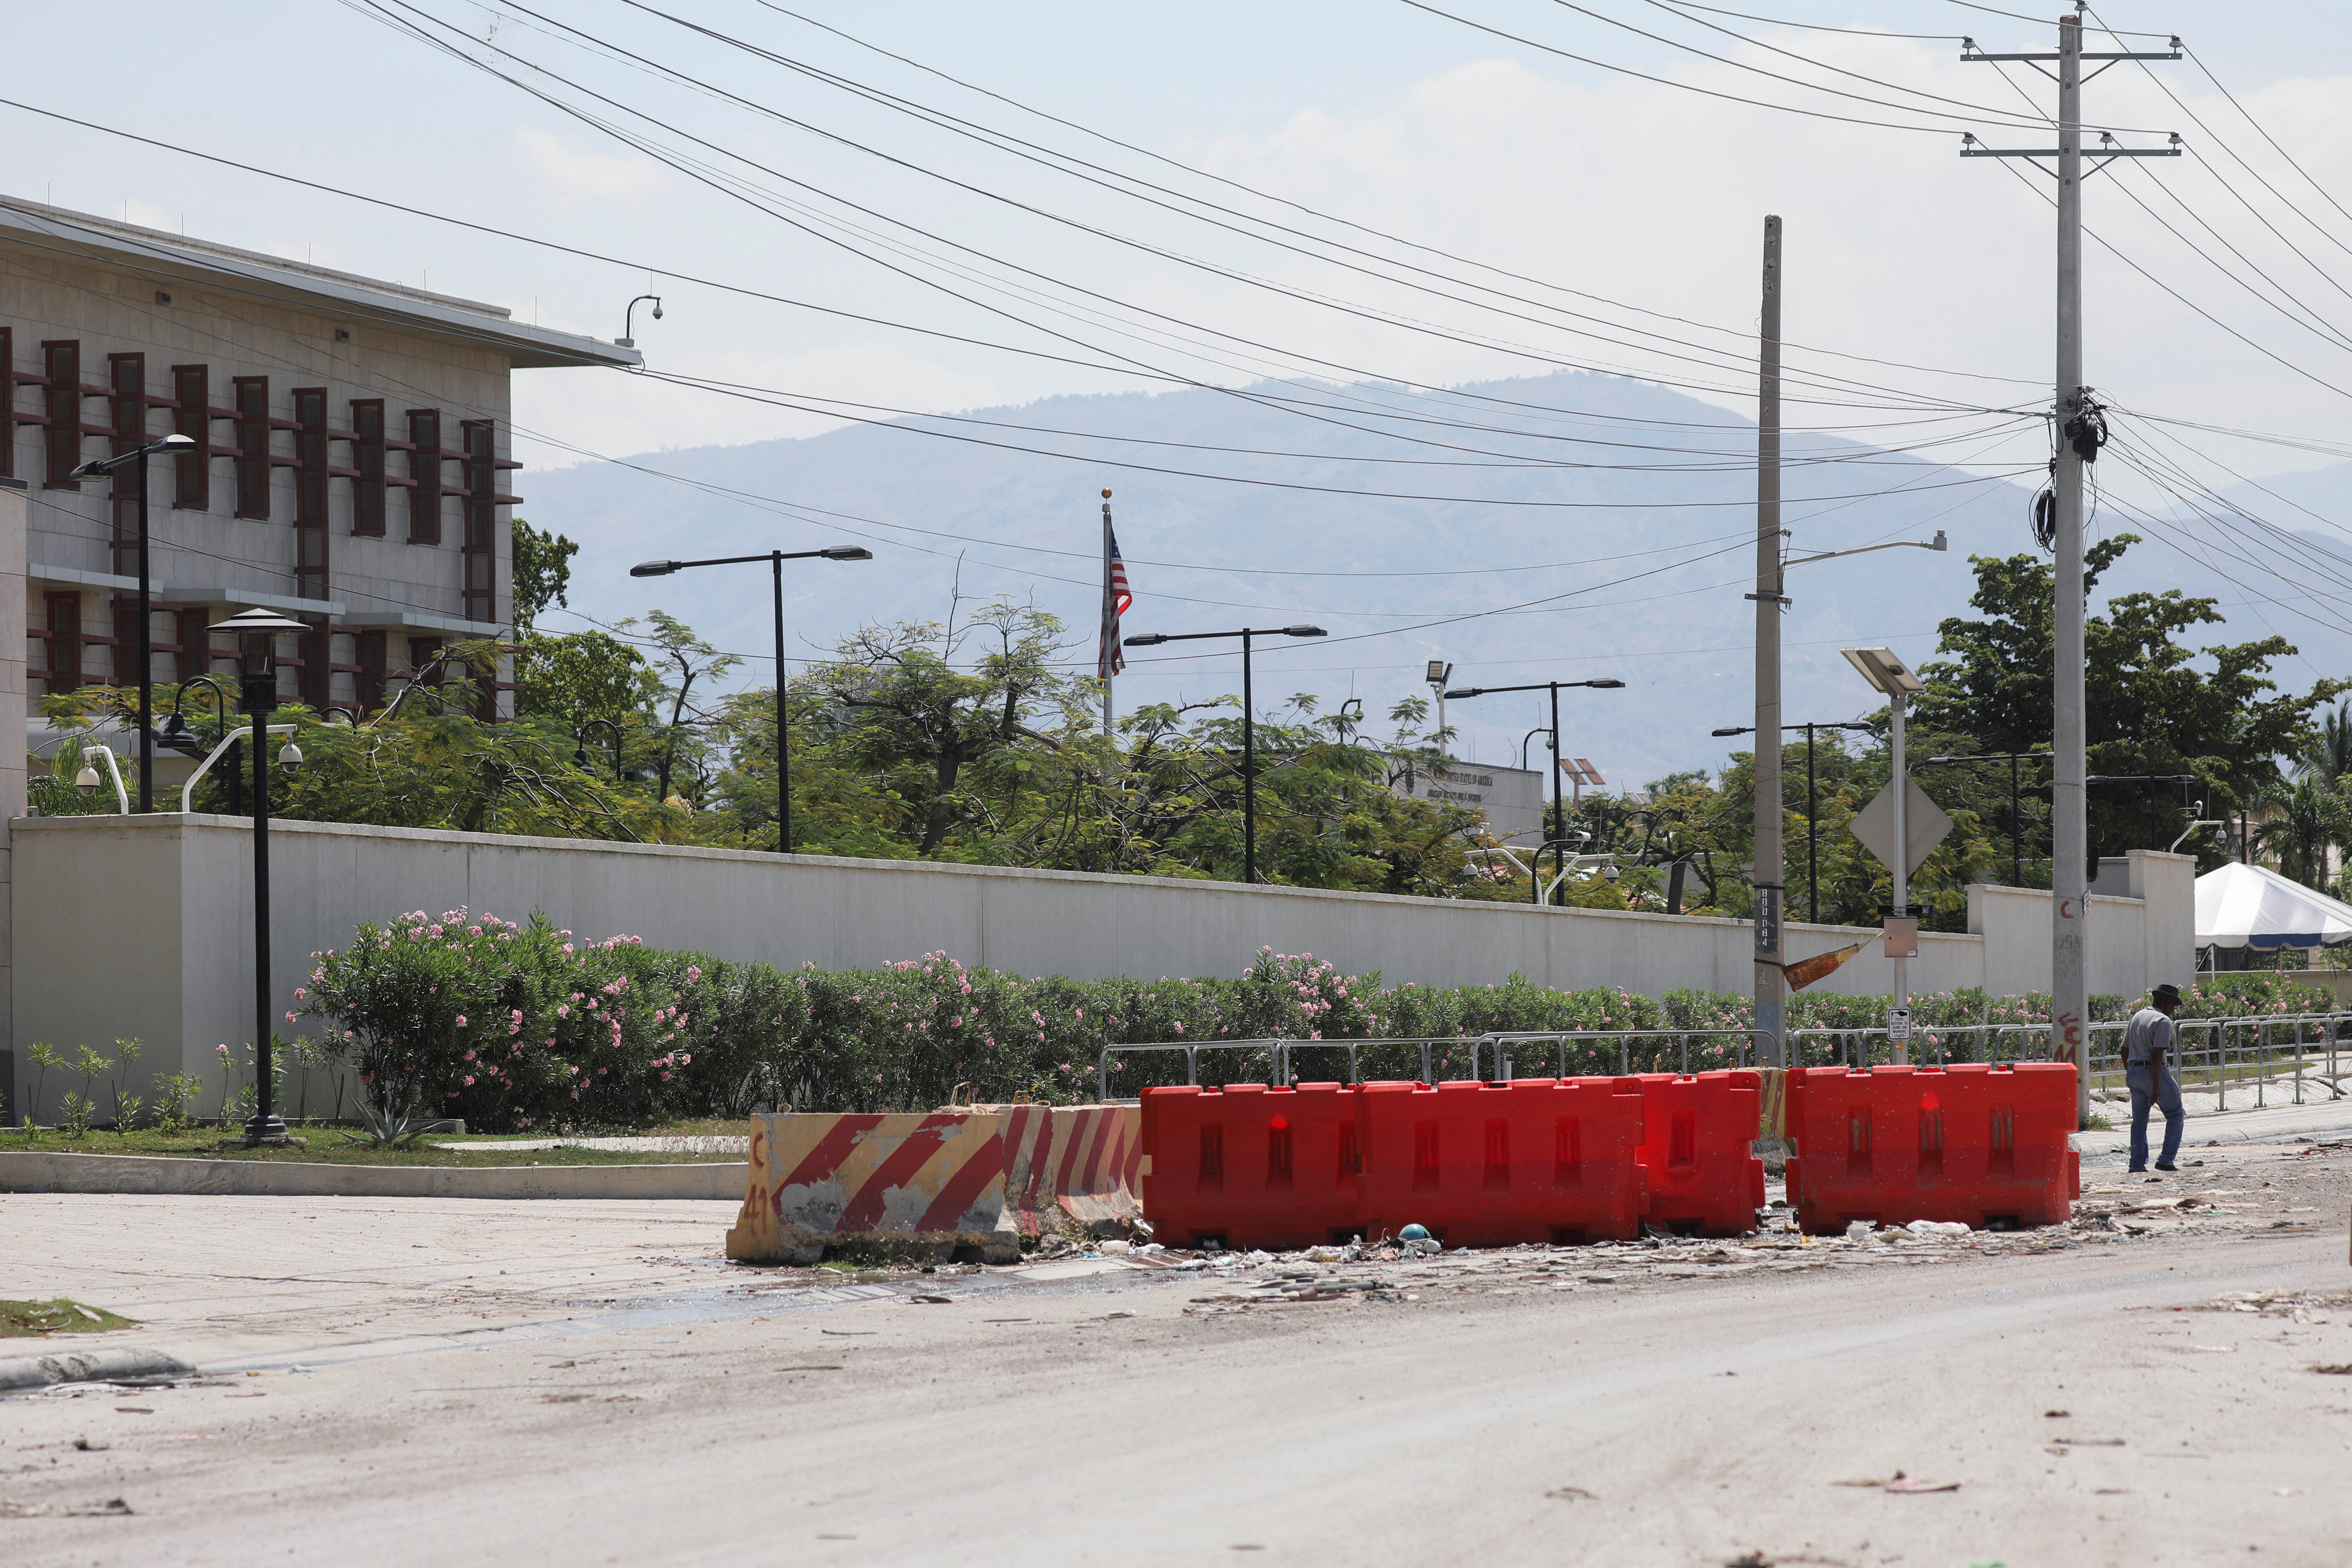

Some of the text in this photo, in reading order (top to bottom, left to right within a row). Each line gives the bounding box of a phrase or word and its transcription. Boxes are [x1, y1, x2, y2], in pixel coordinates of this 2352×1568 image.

[1460, 773, 1472, 784] STATES
[1478, 775, 1493, 787] AMERICA
[744, 1184, 767, 1236] 41
